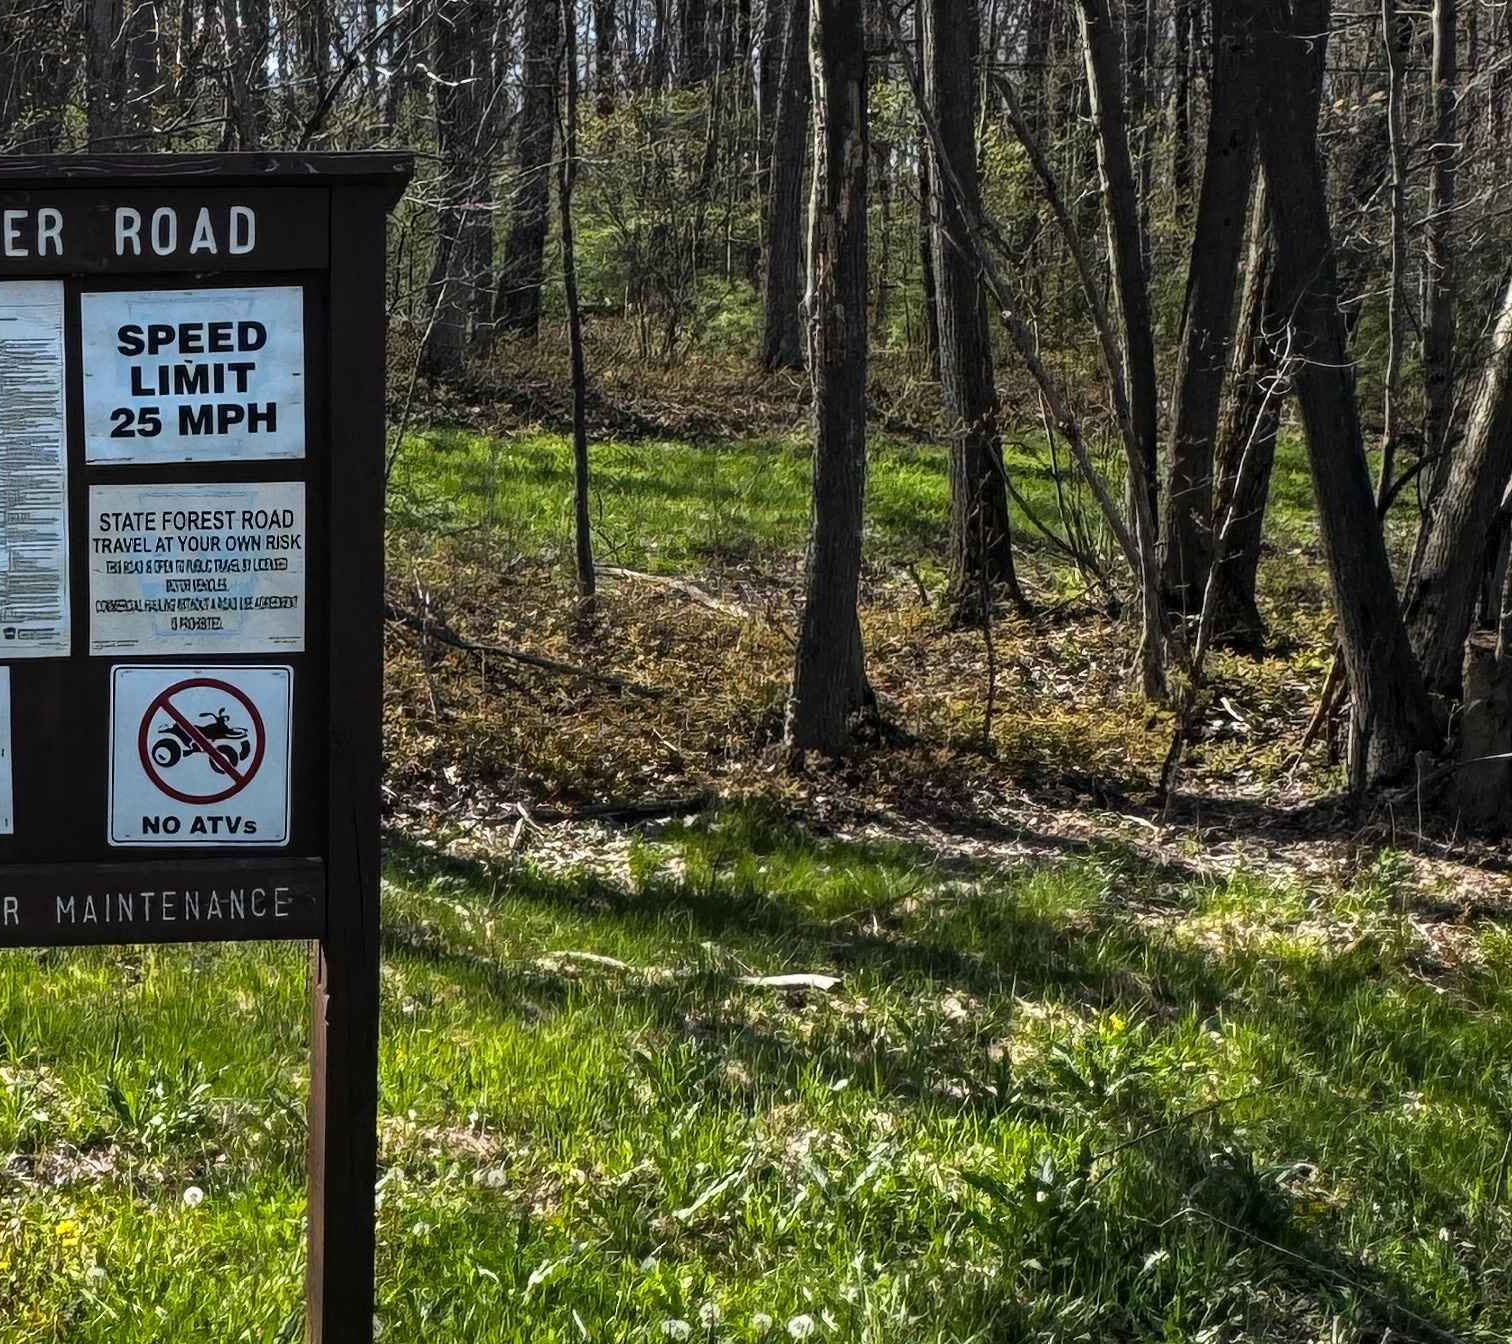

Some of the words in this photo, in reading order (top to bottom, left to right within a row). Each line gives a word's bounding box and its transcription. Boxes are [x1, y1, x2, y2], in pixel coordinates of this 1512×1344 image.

[114, 206, 257, 256] ROAD
[117, 321, 267, 356] SPEED
[131, 362, 256, 396] LIMIT
[110, 407, 162, 438] 25
[178, 402, 277, 436] MPH
[99, 512, 156, 532] STATE
[162, 510, 236, 531] FOREST
[241, 509, 294, 529] ROAD
[92, 537, 152, 553] TRAVEL
[155, 537, 174, 552] AT
[177, 535, 221, 552] YOUR
[225, 535, 261, 551] OWN
[265, 534, 302, 550] RISK
[142, 816, 181, 834] NO
[190, 816, 257, 834] ATVs
[56, 887, 290, 924] MAINTENANCE
